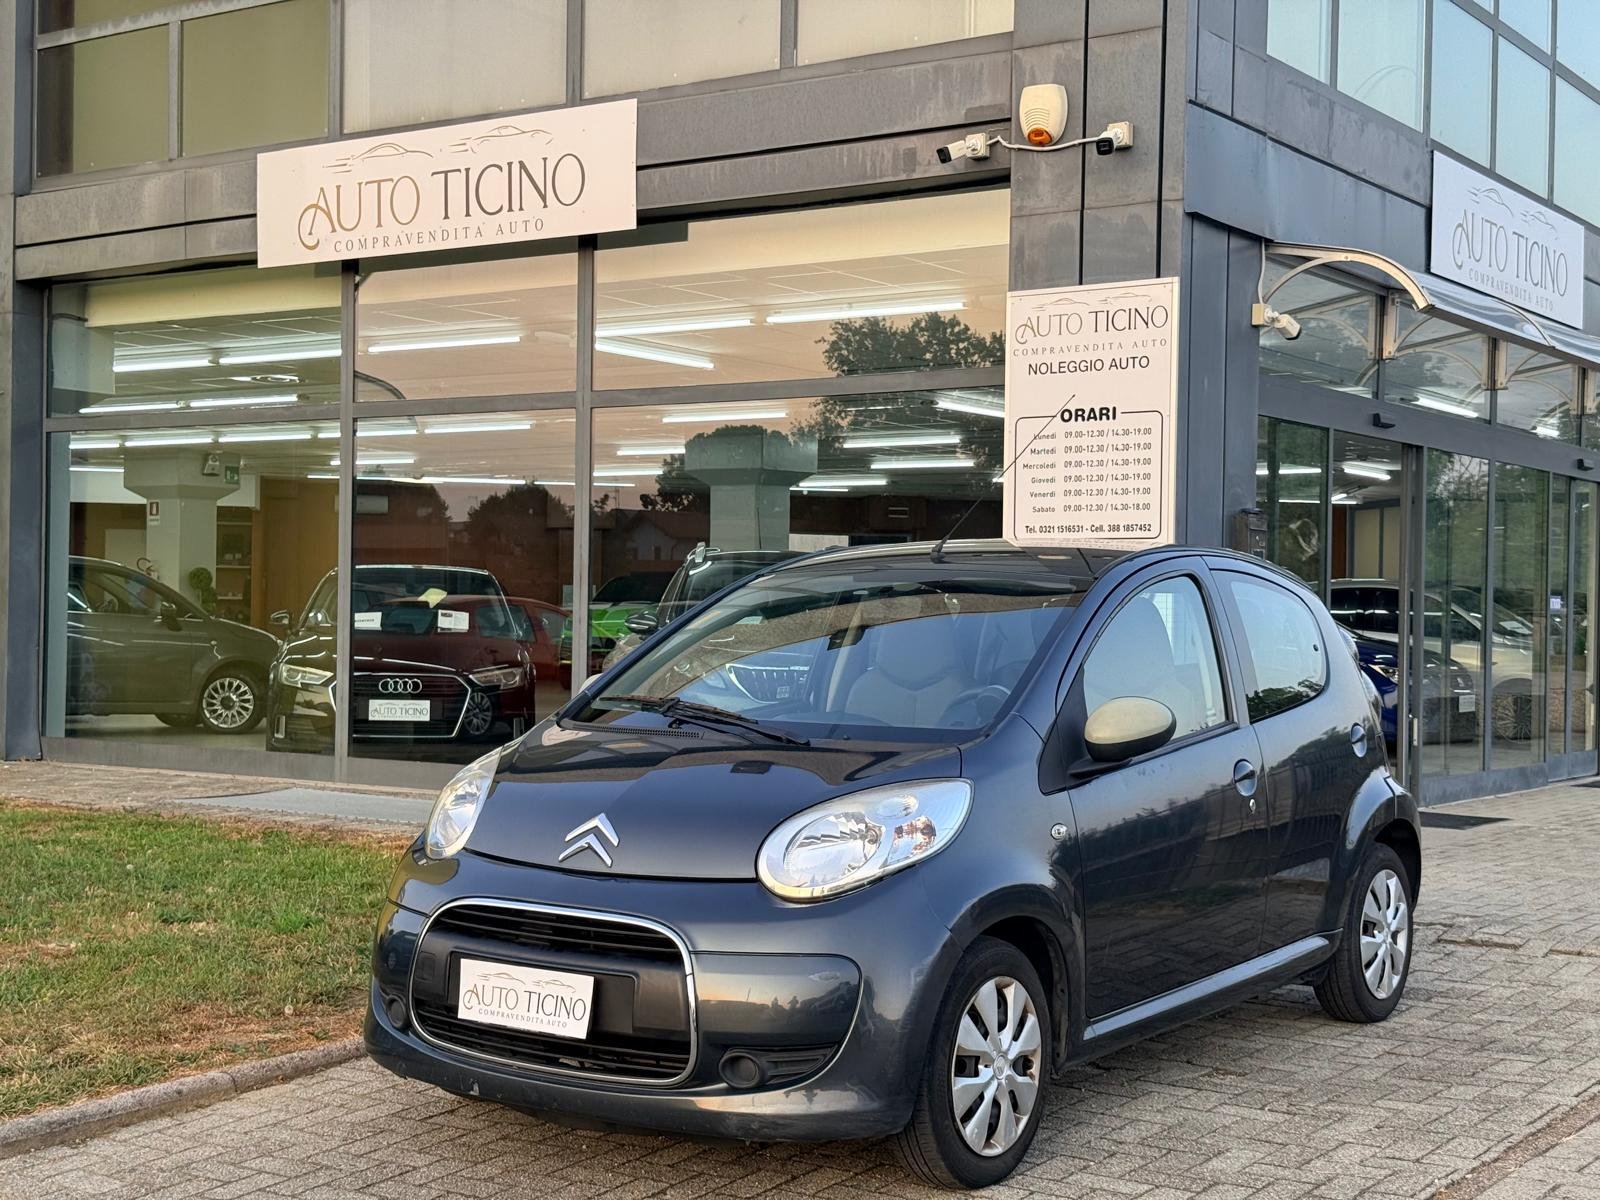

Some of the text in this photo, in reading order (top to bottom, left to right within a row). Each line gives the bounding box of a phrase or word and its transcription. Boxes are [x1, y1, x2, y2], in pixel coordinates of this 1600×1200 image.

[298, 153, 586, 251] AUTO TICINO
[334, 218, 545, 253] COMPRAVENDITA AUTO
[1452, 209, 1568, 297] AUTO TICINO
[1468, 268, 1554, 311] COMPRAVENDITA AUTO
[1015, 305, 1169, 344] AUTO TICINO
[1013, 338, 1167, 357] COMPRAVENDITA AUTO
[1028, 355, 1150, 376] NOLEGGIO AUTO
[1060, 406, 1117, 423] ORARI
[1064, 429, 1104, 439] 09.00-12.30
[1111, 427, 1152, 437] 14.30-19.00
[1064, 444, 1104, 454] 09.00-12.30
[1111, 442, 1152, 452] 14.30-19.00
[1064, 460, 1104, 469] 09.00-12.30
[1111, 458, 1151, 467] 14.30-19.00
[1063, 474, 1104, 483] 09.00-12.30
[1110, 473, 1151, 481] 14.30-19.00
[1063, 488, 1104, 497] 09.00-12.30
[1110, 487, 1151, 496] 14.30-19.00
[1032, 505, 1056, 513] Sabato
[1063, 503, 1104, 513] 09.00-12.30
[1110, 502, 1151, 511] 14.30-18.00
[1025, 525, 1037, 534] Tel.
[1039, 525, 1055, 534] 0321
[1057, 525, 1084, 533] 1516531
[1090, 524, 1106, 533] Cell.
[1107, 524, 1121, 532] 388
[1122, 523, 1152, 532] 1857452
[371, 706, 429, 718] AUTO TICINO
[463, 983, 587, 1021] AUTO TICINO
[478, 1008, 568, 1028] COMPRAVENDITA AUTO
